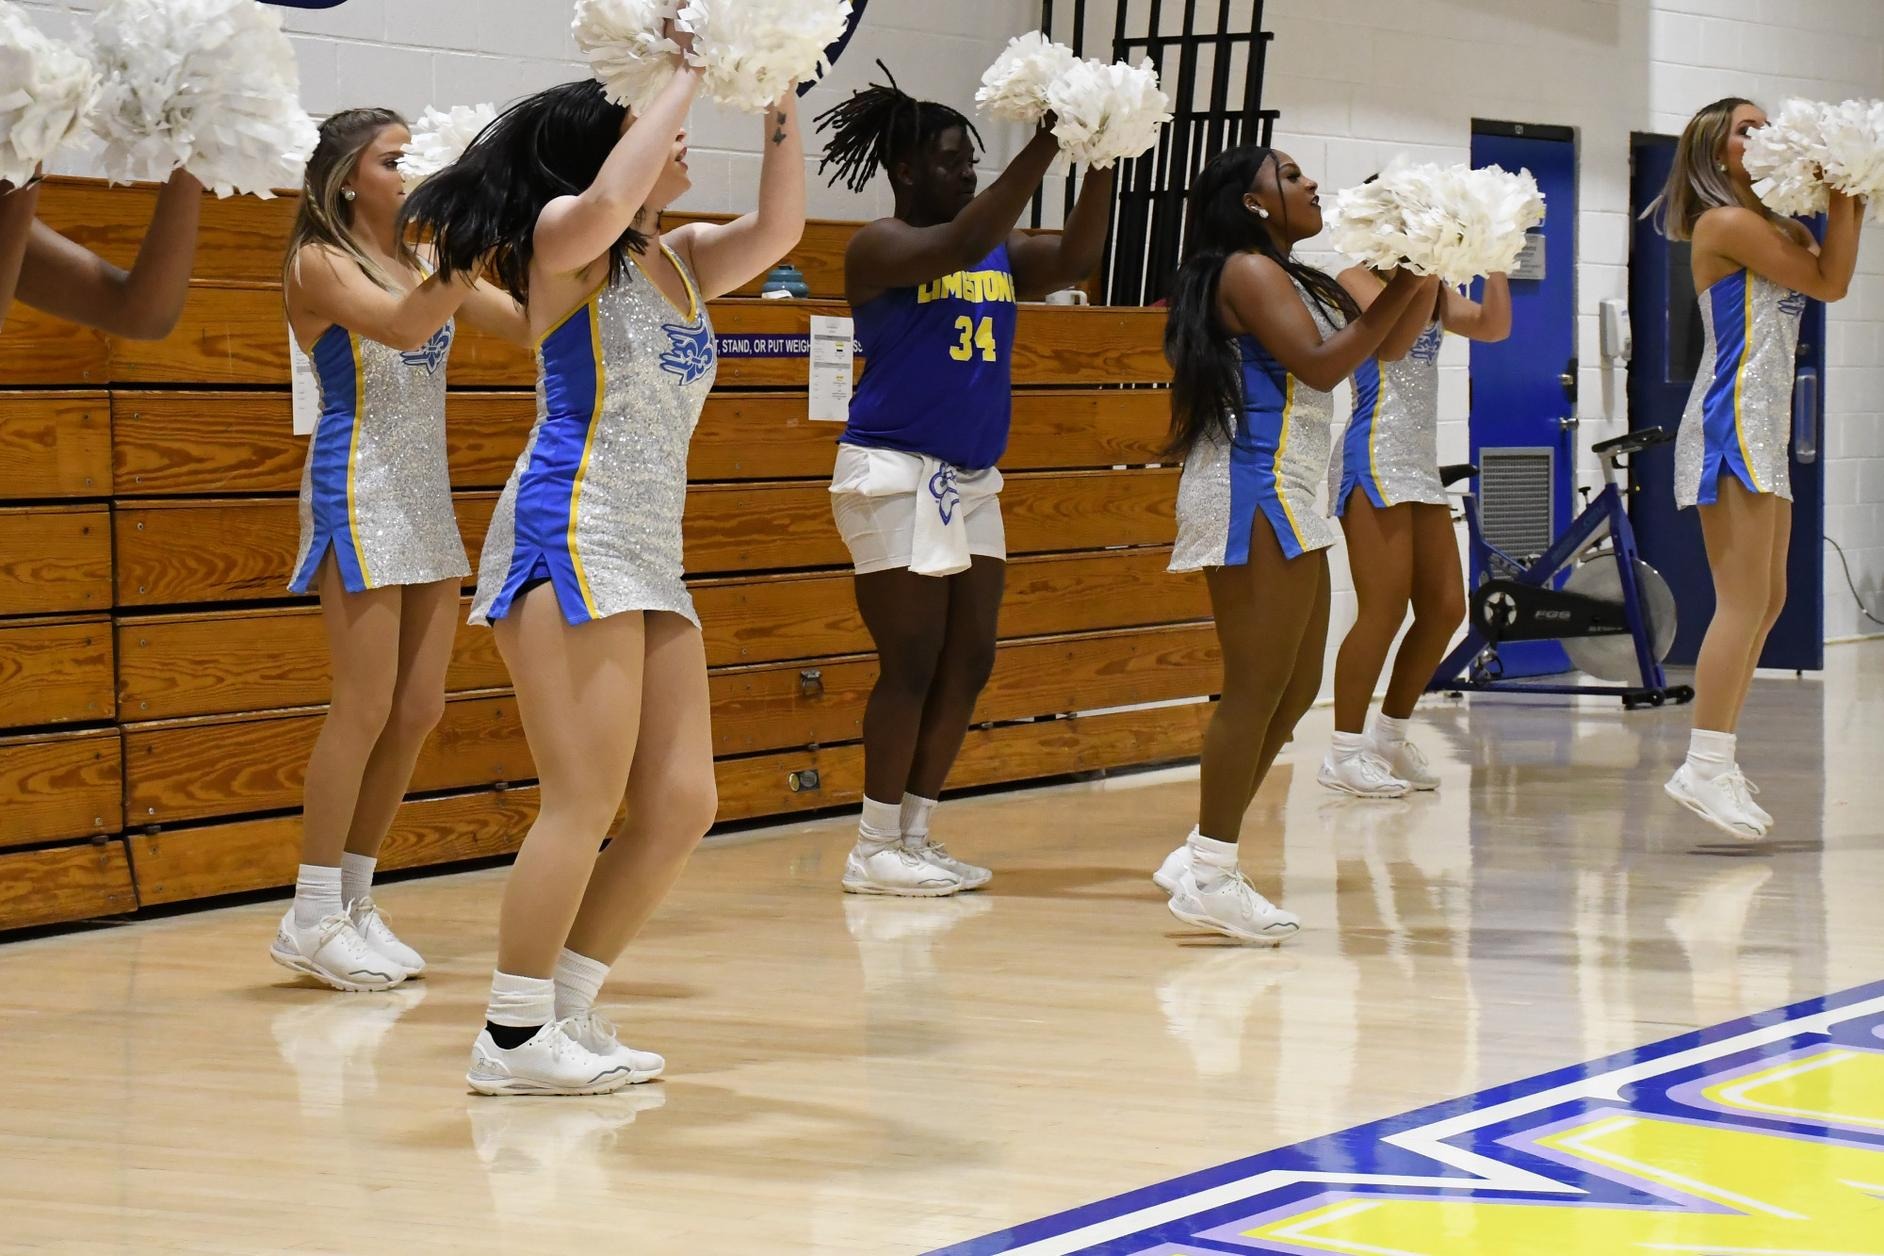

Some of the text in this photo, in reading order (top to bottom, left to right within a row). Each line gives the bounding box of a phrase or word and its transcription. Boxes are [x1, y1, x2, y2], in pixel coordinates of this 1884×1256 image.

[917, 269, 1016, 304] LIMTON
[722, 339, 752, 354] STAND,
[753, 339, 767, 353] OR
[768, 339, 785, 353] PUT
[949, 315, 996, 361] 34
